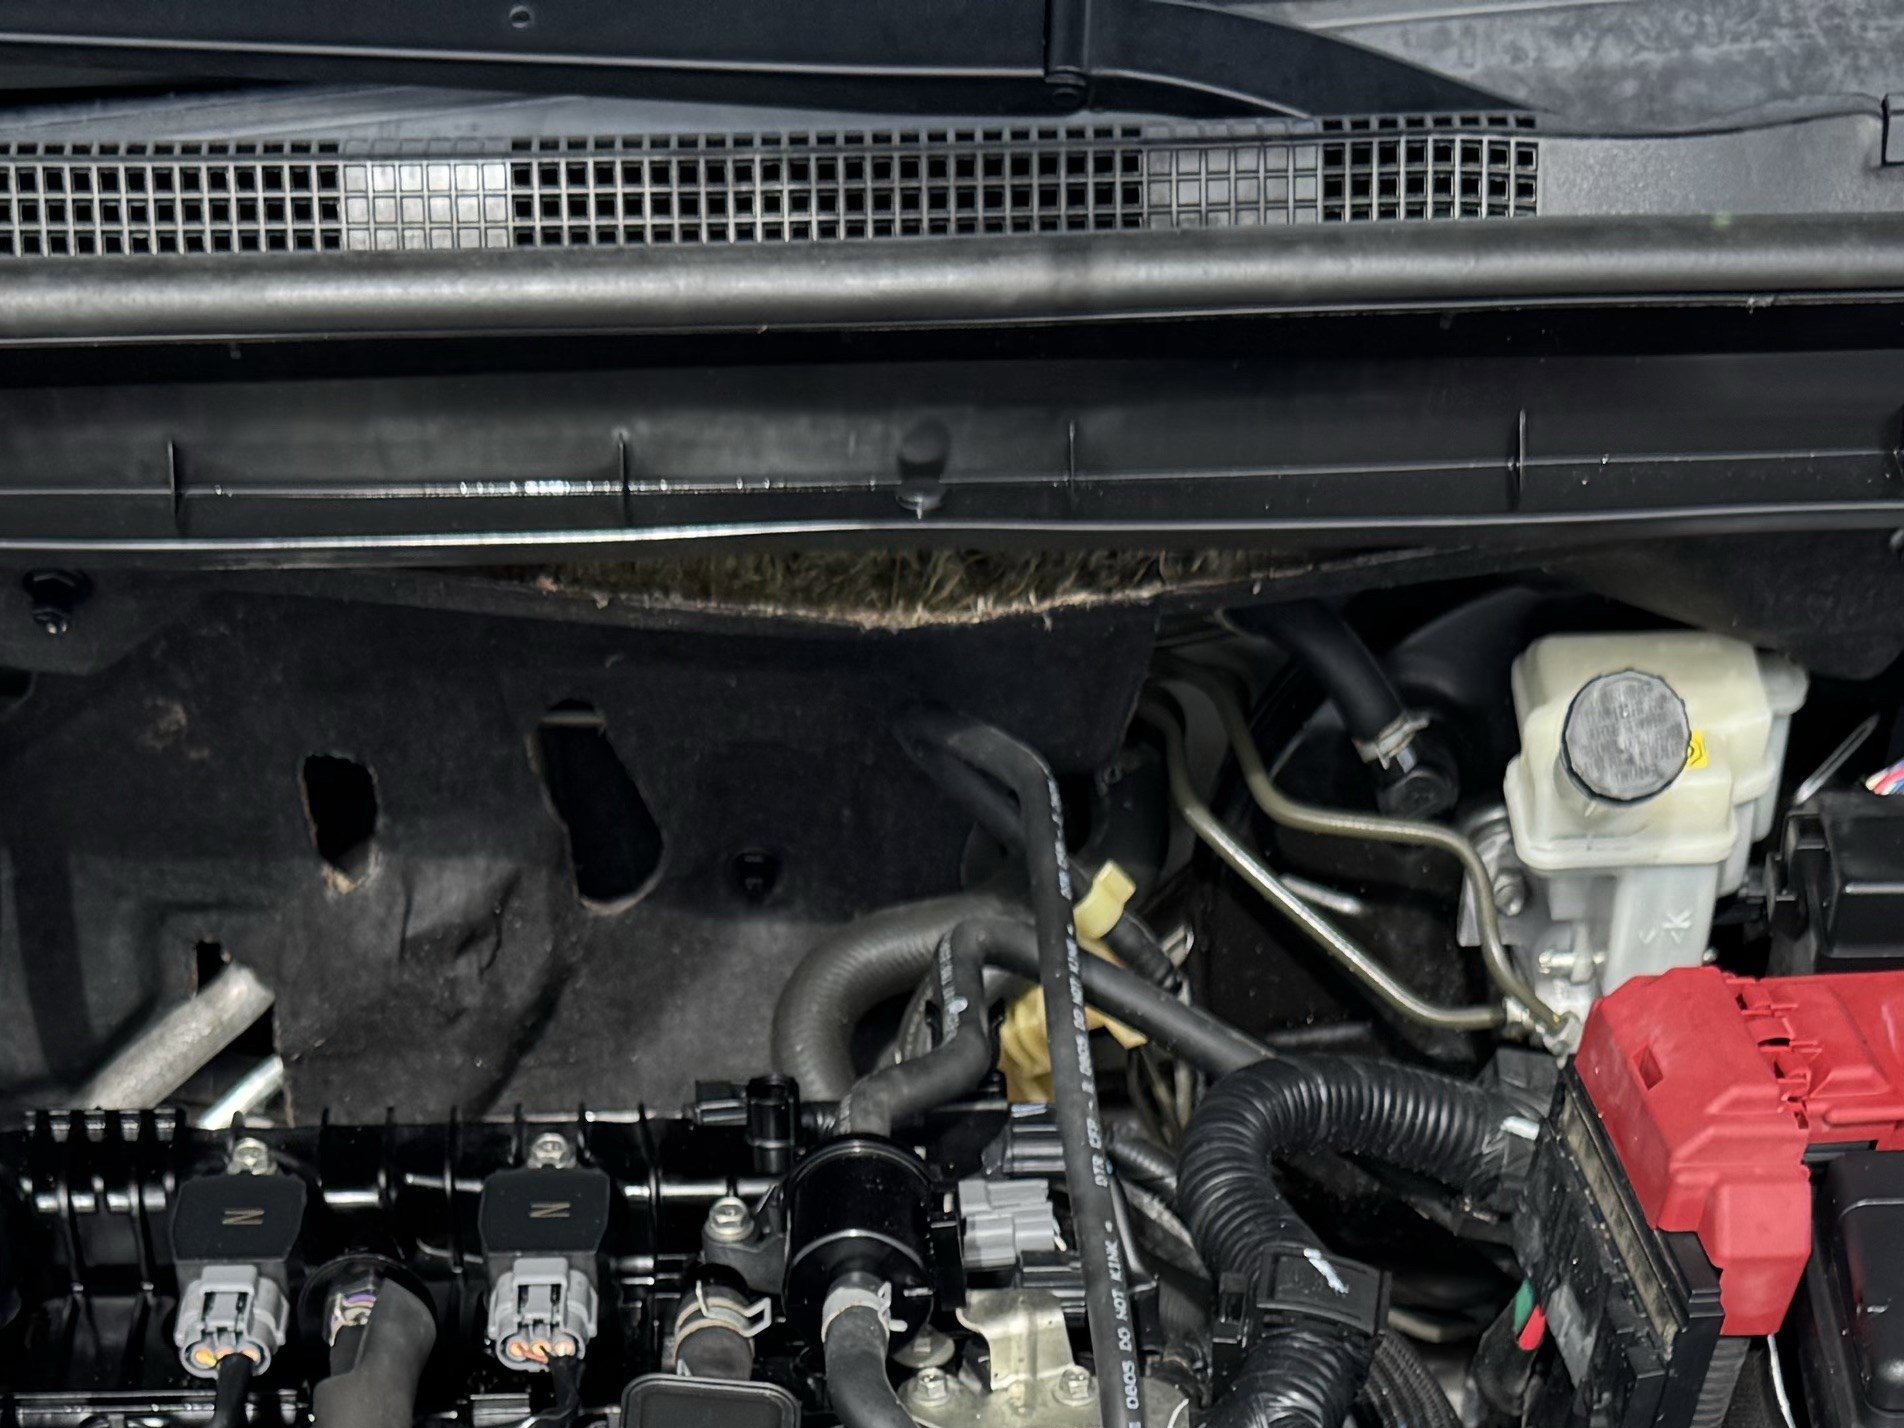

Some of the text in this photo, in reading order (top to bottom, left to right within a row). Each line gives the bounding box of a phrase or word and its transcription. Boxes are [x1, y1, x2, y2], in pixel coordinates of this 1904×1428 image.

[1105, 1240, 1122, 1282] KINK
[1111, 1288, 1128, 1322] NOT
[1117, 1326, 1133, 1352] DO
